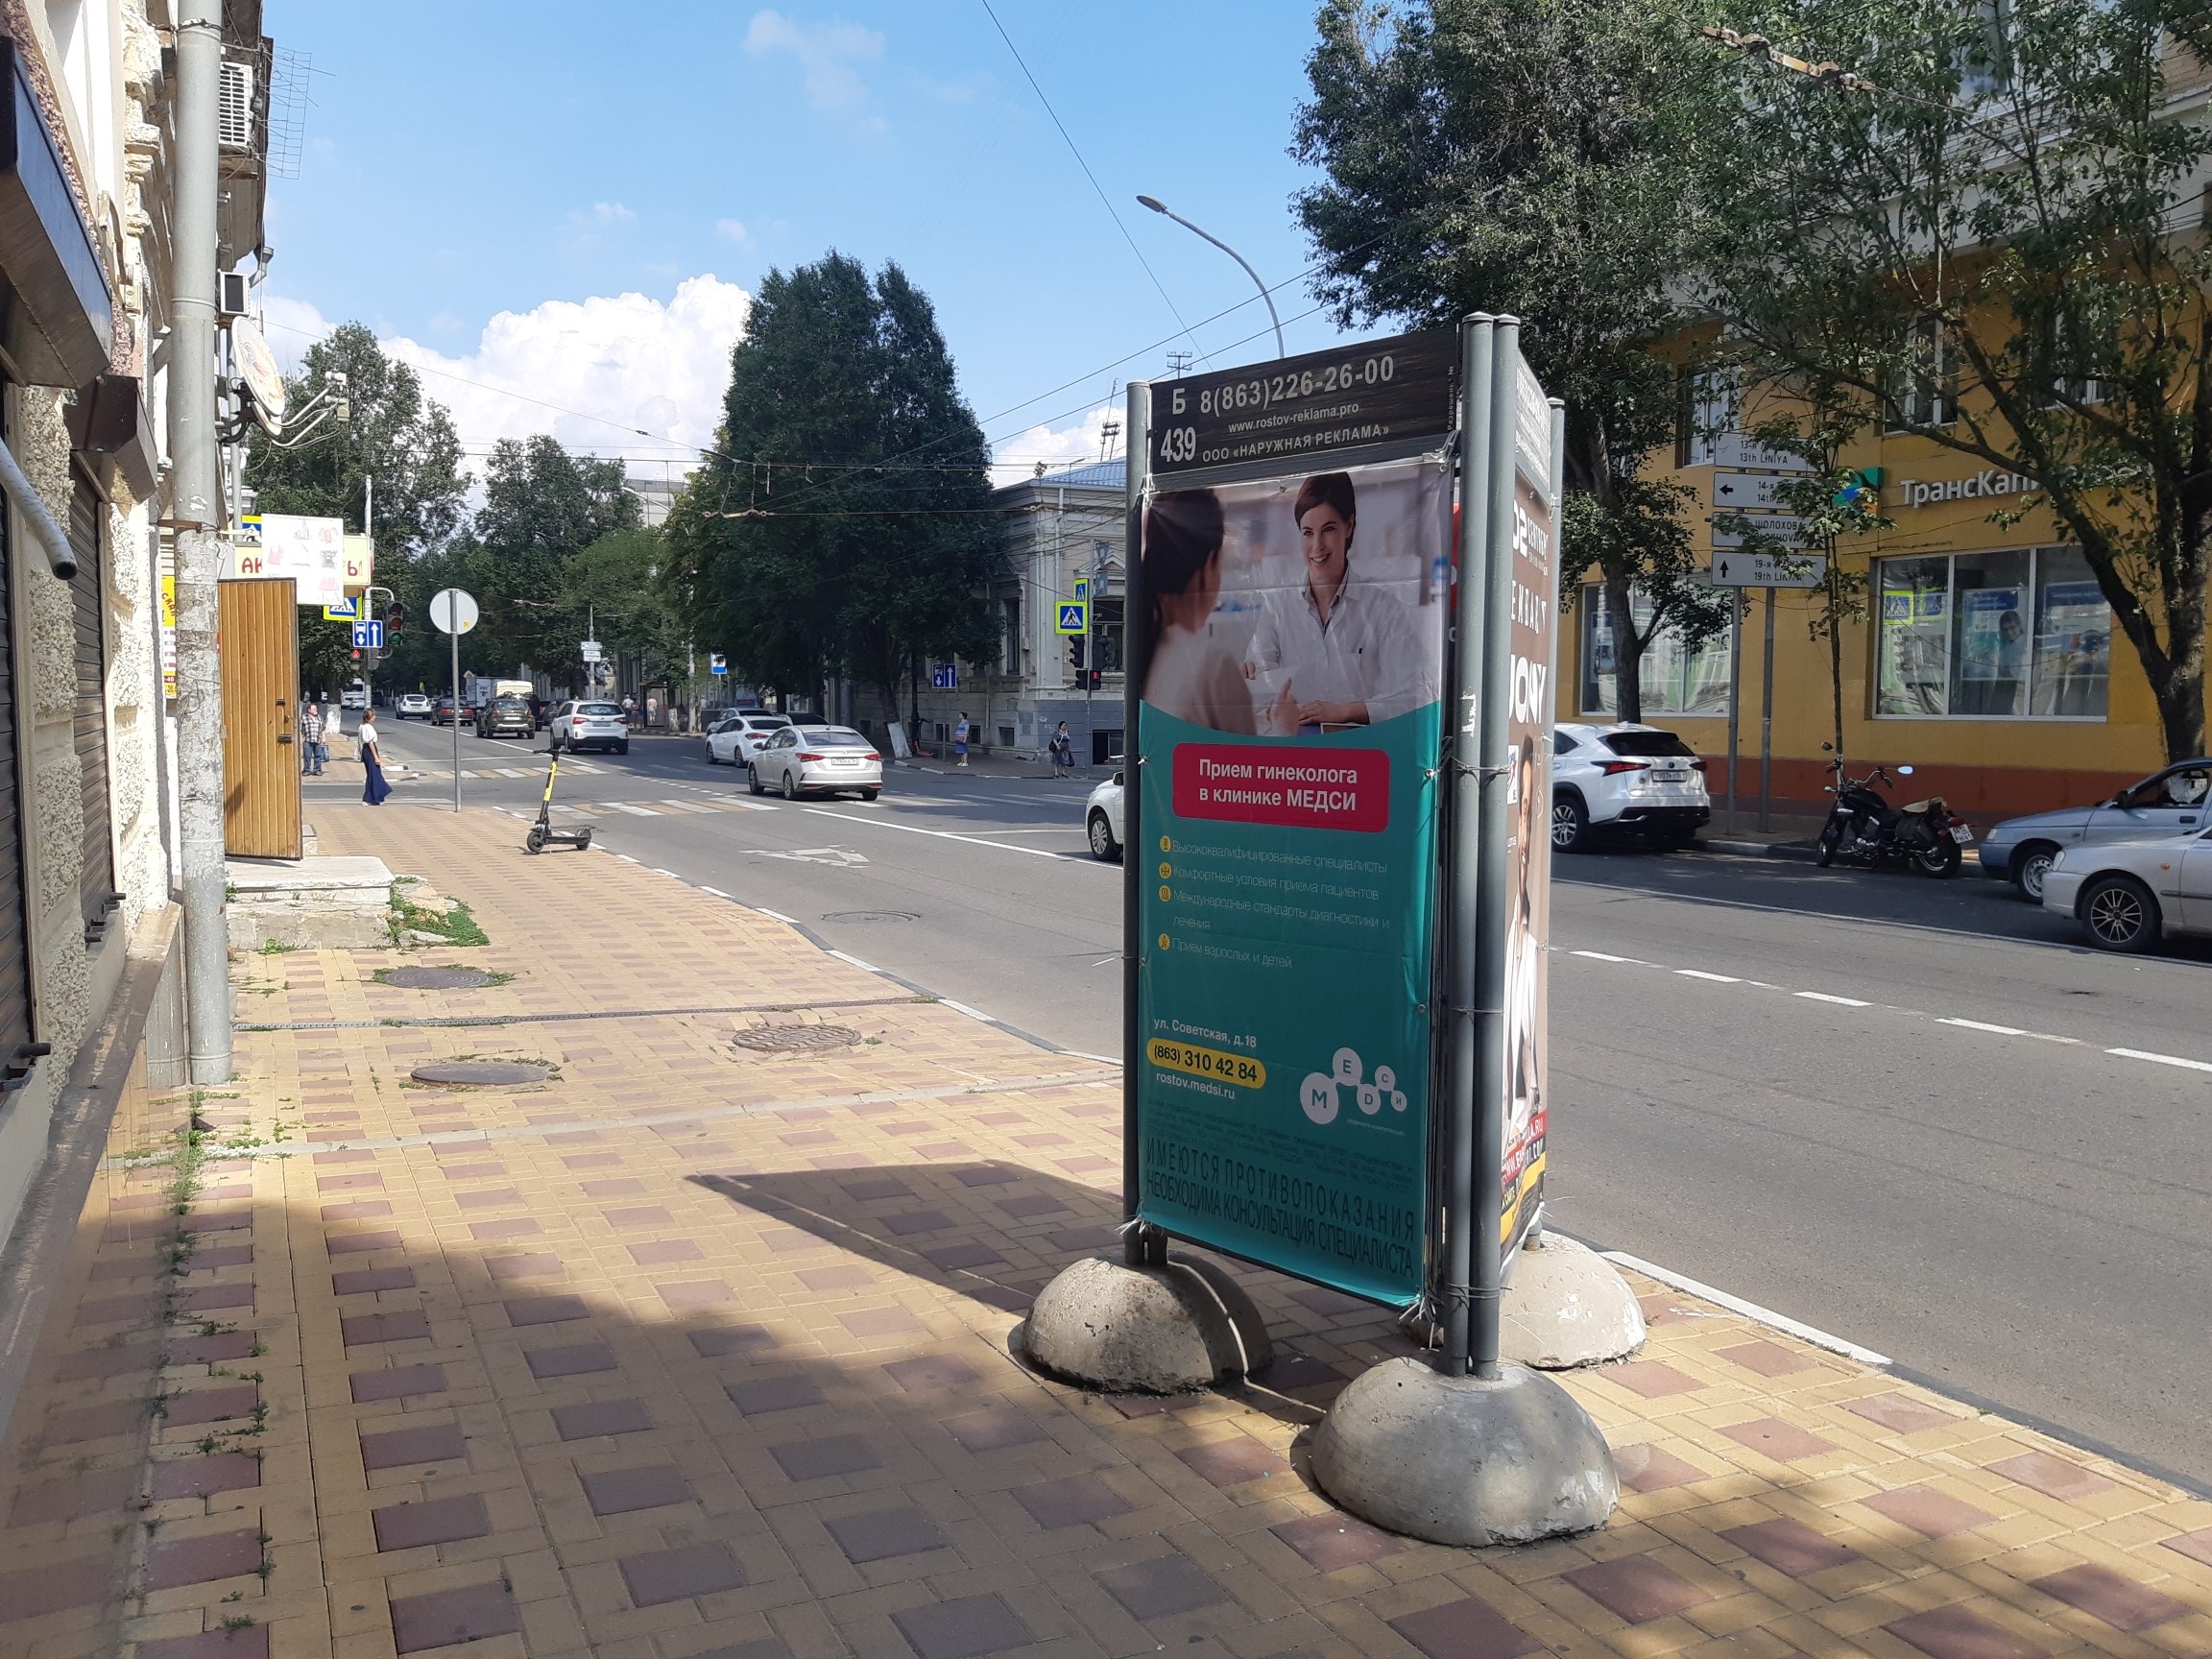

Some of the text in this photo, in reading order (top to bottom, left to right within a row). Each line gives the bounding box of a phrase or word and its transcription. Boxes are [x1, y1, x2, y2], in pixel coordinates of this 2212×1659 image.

[1171, 387, 1186, 415] Б
[1199, 355, 1394, 417] 8(863)226-26-00
[1228, 401, 1359, 434] www.rostov-reklama.pro
[1160, 426, 1196, 463] 439
[1202, 425, 1390, 463] ООО «НАРУЖНАЯ РЕКЛАМА»
[1739, 452, 1757, 462] 13th
[1899, 469, 2039, 509] ТрансКап
[1754, 571, 1771, 581] 19th
[1199, 758, 1358, 784] Прием гинеколога
[1199, 787, 1357, 813] в клинике МЕДСИ
[1172, 840, 1387, 873] Высококвалифицированные специалисты
[1173, 866, 1380, 901] Комфортные условия приема пациентов
[1173, 889, 1390, 929] Международные стандарты диагностики и
[1173, 916, 1211, 929] лечения
[1172, 937, 1292, 968] Прием взрослых и детей
[1153, 1018, 1257, 1048] ул. Советская, д.18
[1153, 1044, 1258, 1082] (863) 310 42 84
[1156, 1072, 1236, 1099] rostov.medsi.ru
[1146, 1137, 1219, 1184] ИМЕЮТСЯ
[1225, 1159, 1414, 1242] ПРОТИВОПОКАЗАНИЯ
[1146, 1168, 1414, 1279] НЕОБХОДИМА КОНСУЛЬТАЦИЯ СПЕЦИАЛИСТА
